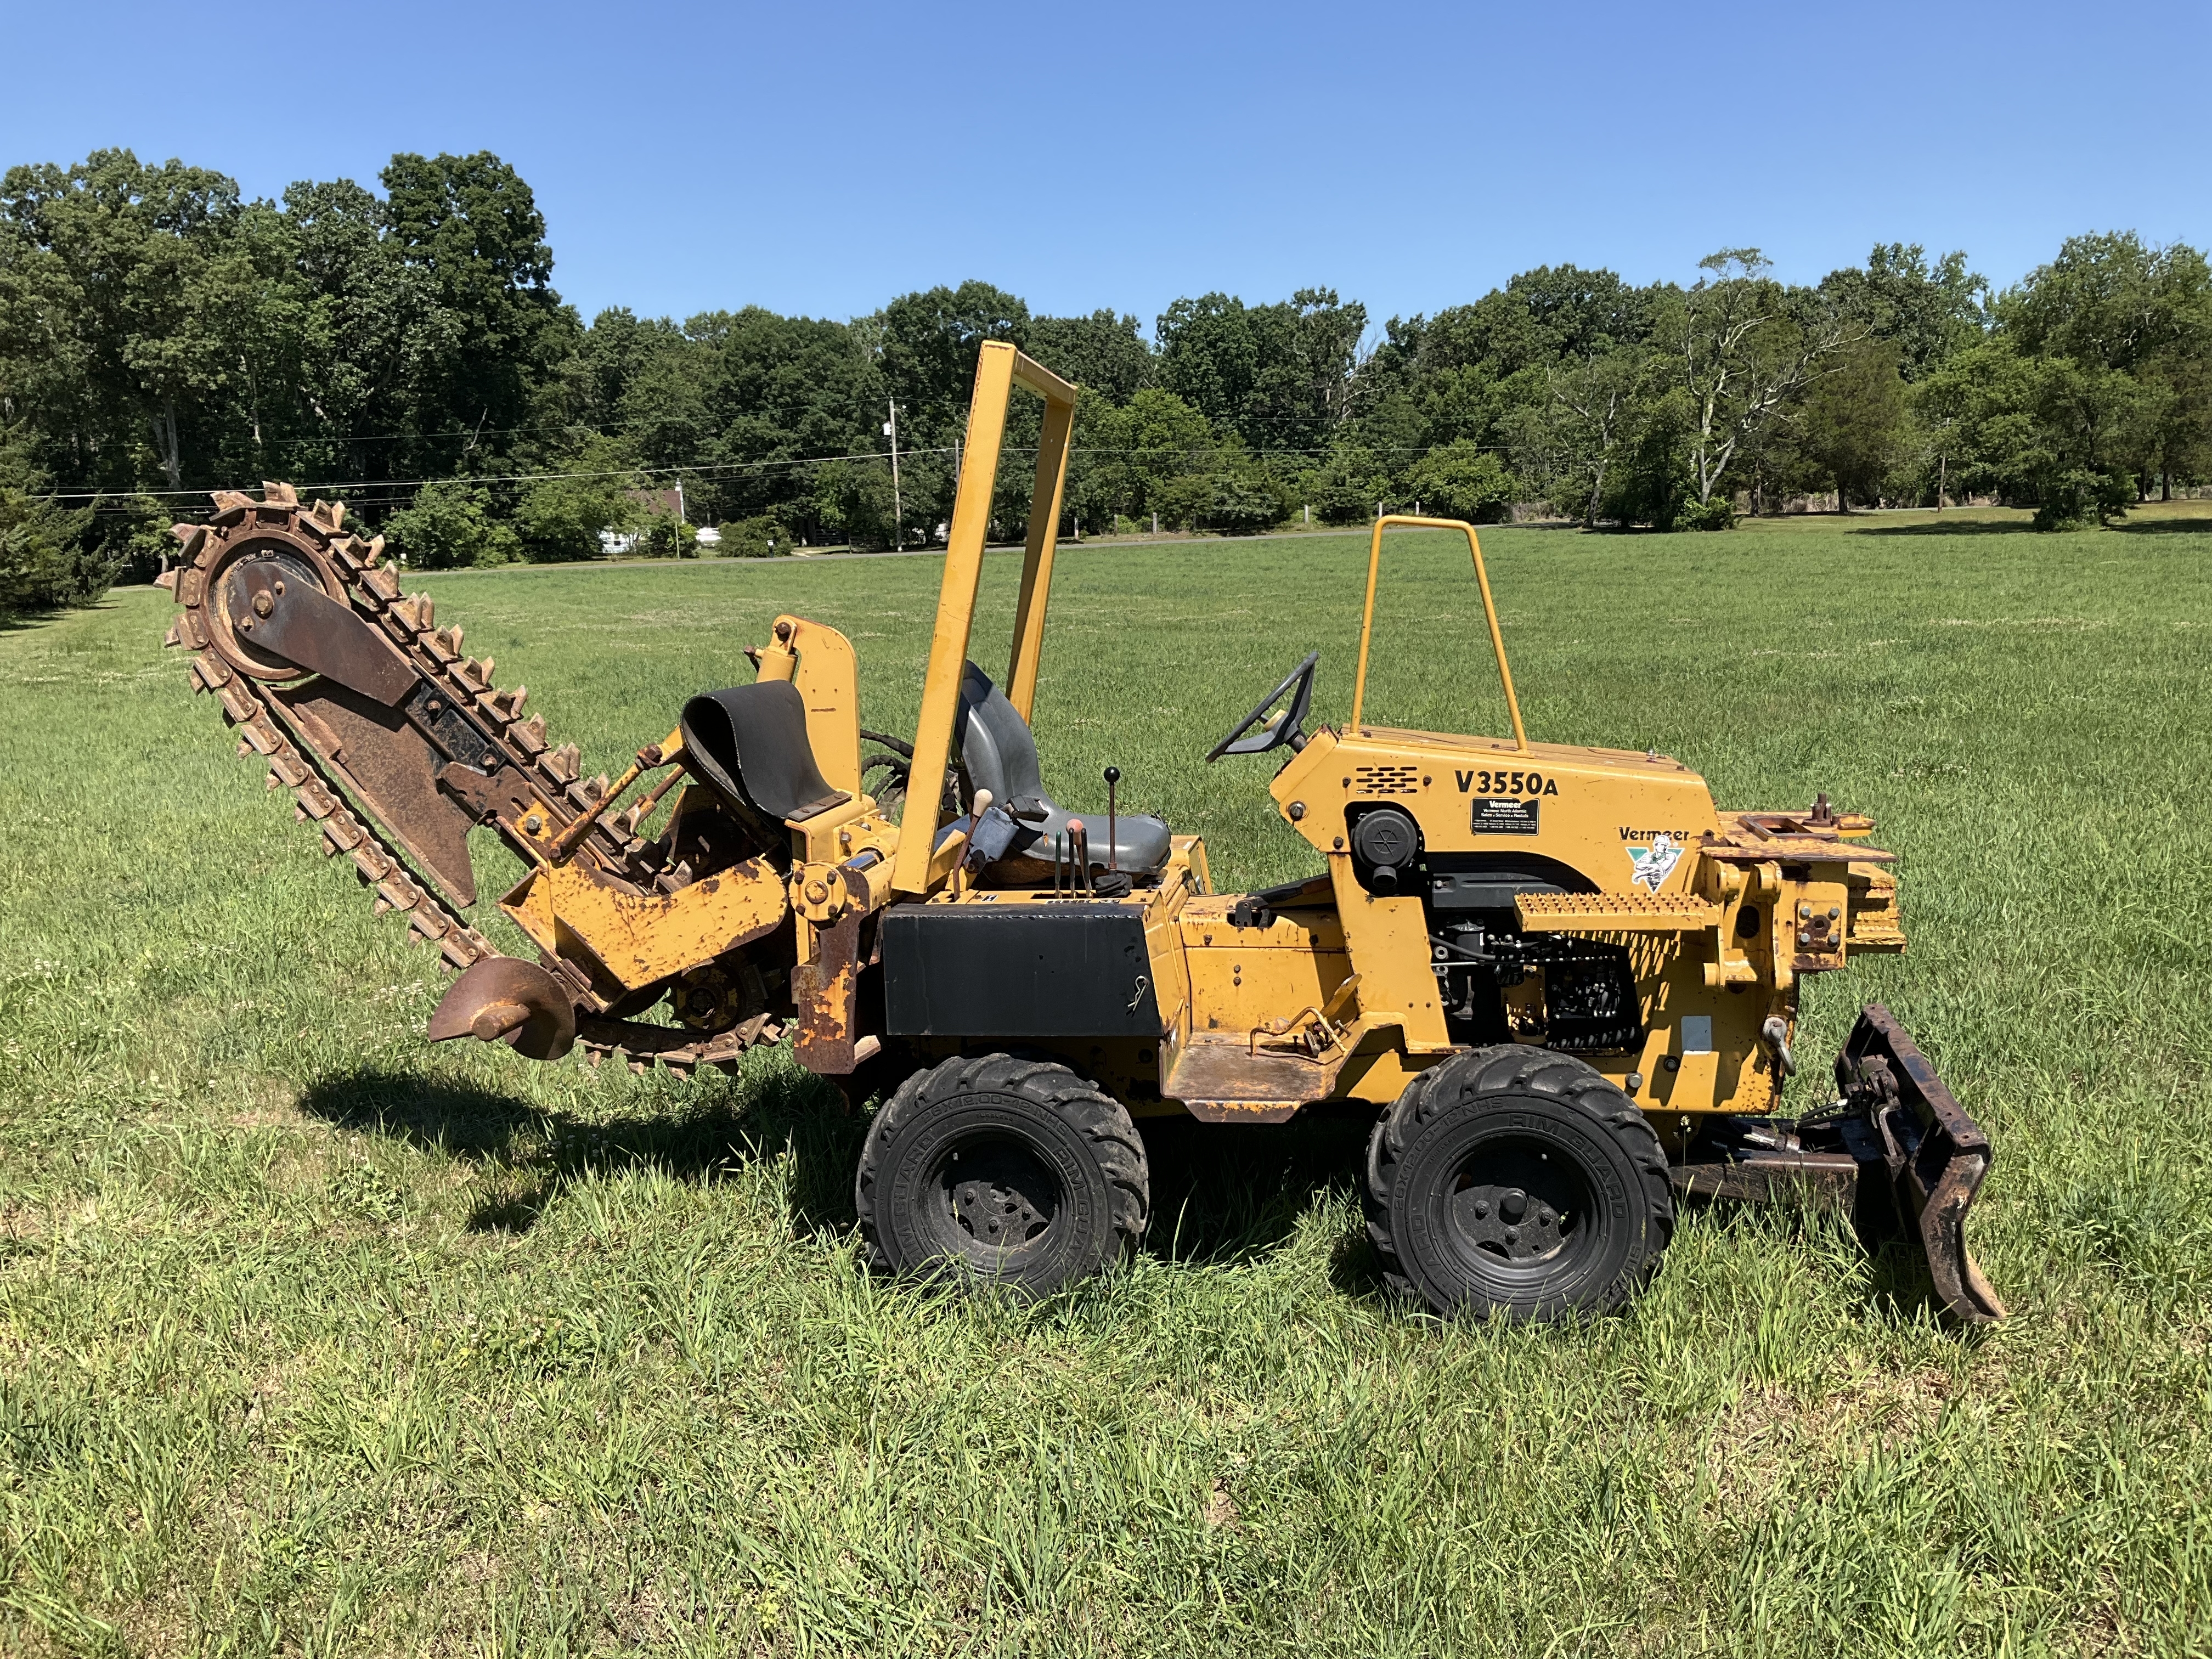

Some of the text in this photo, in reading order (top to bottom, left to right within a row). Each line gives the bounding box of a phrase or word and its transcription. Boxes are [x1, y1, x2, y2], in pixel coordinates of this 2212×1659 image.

[1454, 770, 1559, 795] V3550A
[1489, 800, 1522, 809] Vermeer
[1618, 826, 1690, 840] Vermeer
[1462, 1098, 1503, 1117] NHS
[1034, 1108, 1070, 1136] NHS
[894, 1133, 935, 1216] GUARD
[1053, 1147, 1085, 1191] RIM
[1509, 1114, 1627, 1219] RIM GUARD
